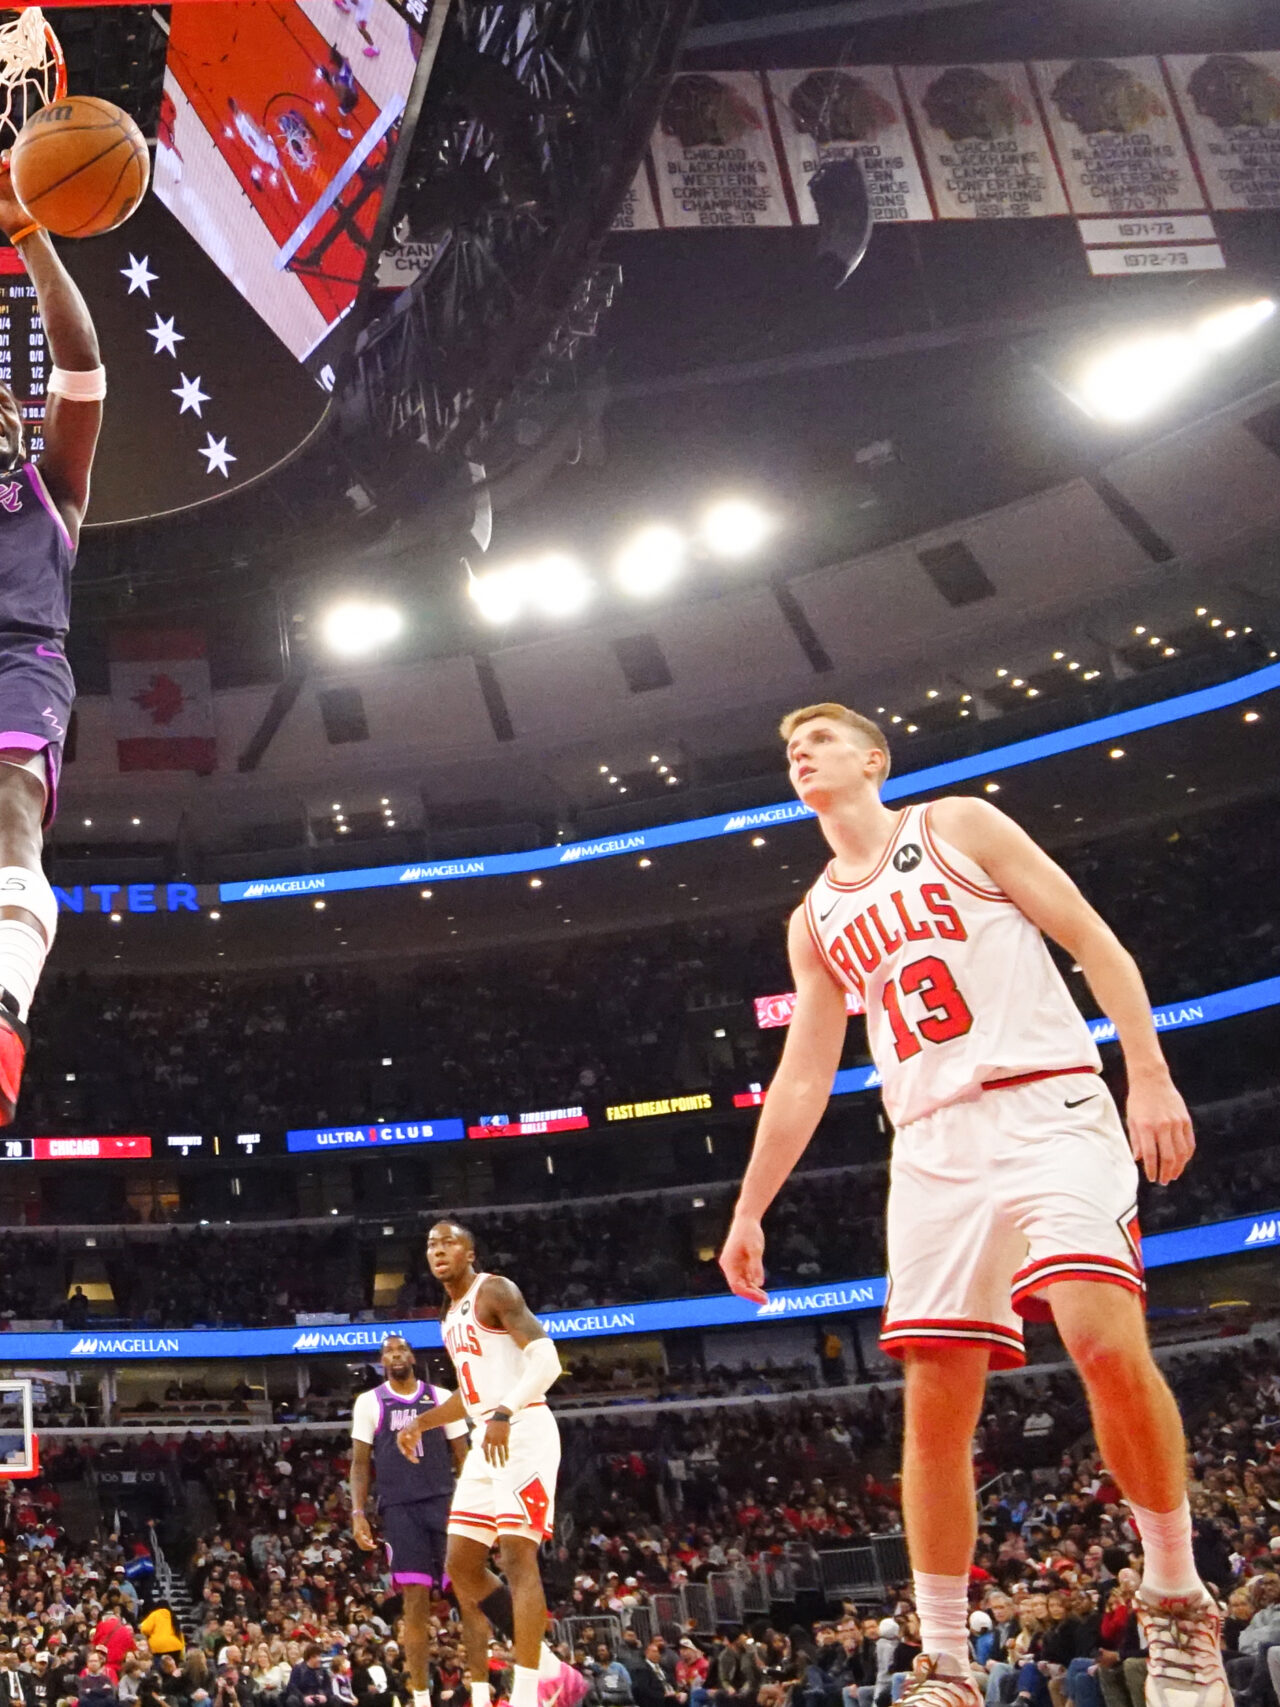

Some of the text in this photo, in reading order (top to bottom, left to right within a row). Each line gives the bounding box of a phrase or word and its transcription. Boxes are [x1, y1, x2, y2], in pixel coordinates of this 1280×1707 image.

[667, 161, 767, 174] BLACKHAWKS
[683, 174, 757, 185] WESTERN
[672, 187, 772, 199] CONFERENCE
[682, 200, 767, 212] CHAMPIONS
[1124, 253, 1188, 267] 1972-73
[31, 366, 44, 379] 1/2
[30, 383, 44, 395] 3/4
[30, 437, 44, 450] 2/2
[582, 836, 645, 857] MAGELLAN
[421, 861, 484, 878] MAGELLAN
[1, 877, 27, 892] 5
[263, 878, 326, 894] MAGELLAN
[54, 883, 200, 913] NTER
[829, 883, 968, 999] BULLS
[882, 955, 974, 1063] 13
[606, 1094, 712, 1121] FAST BREAK POINTS
[316, 1126, 433, 1145] ULTRA CLUB
[49, 1139, 100, 1156] CHICAGO
[787, 1287, 873, 1311] MAGELLAN
[551, 1313, 635, 1333] MAGELLAN
[98, 1338, 179, 1353] MAGELLAN
